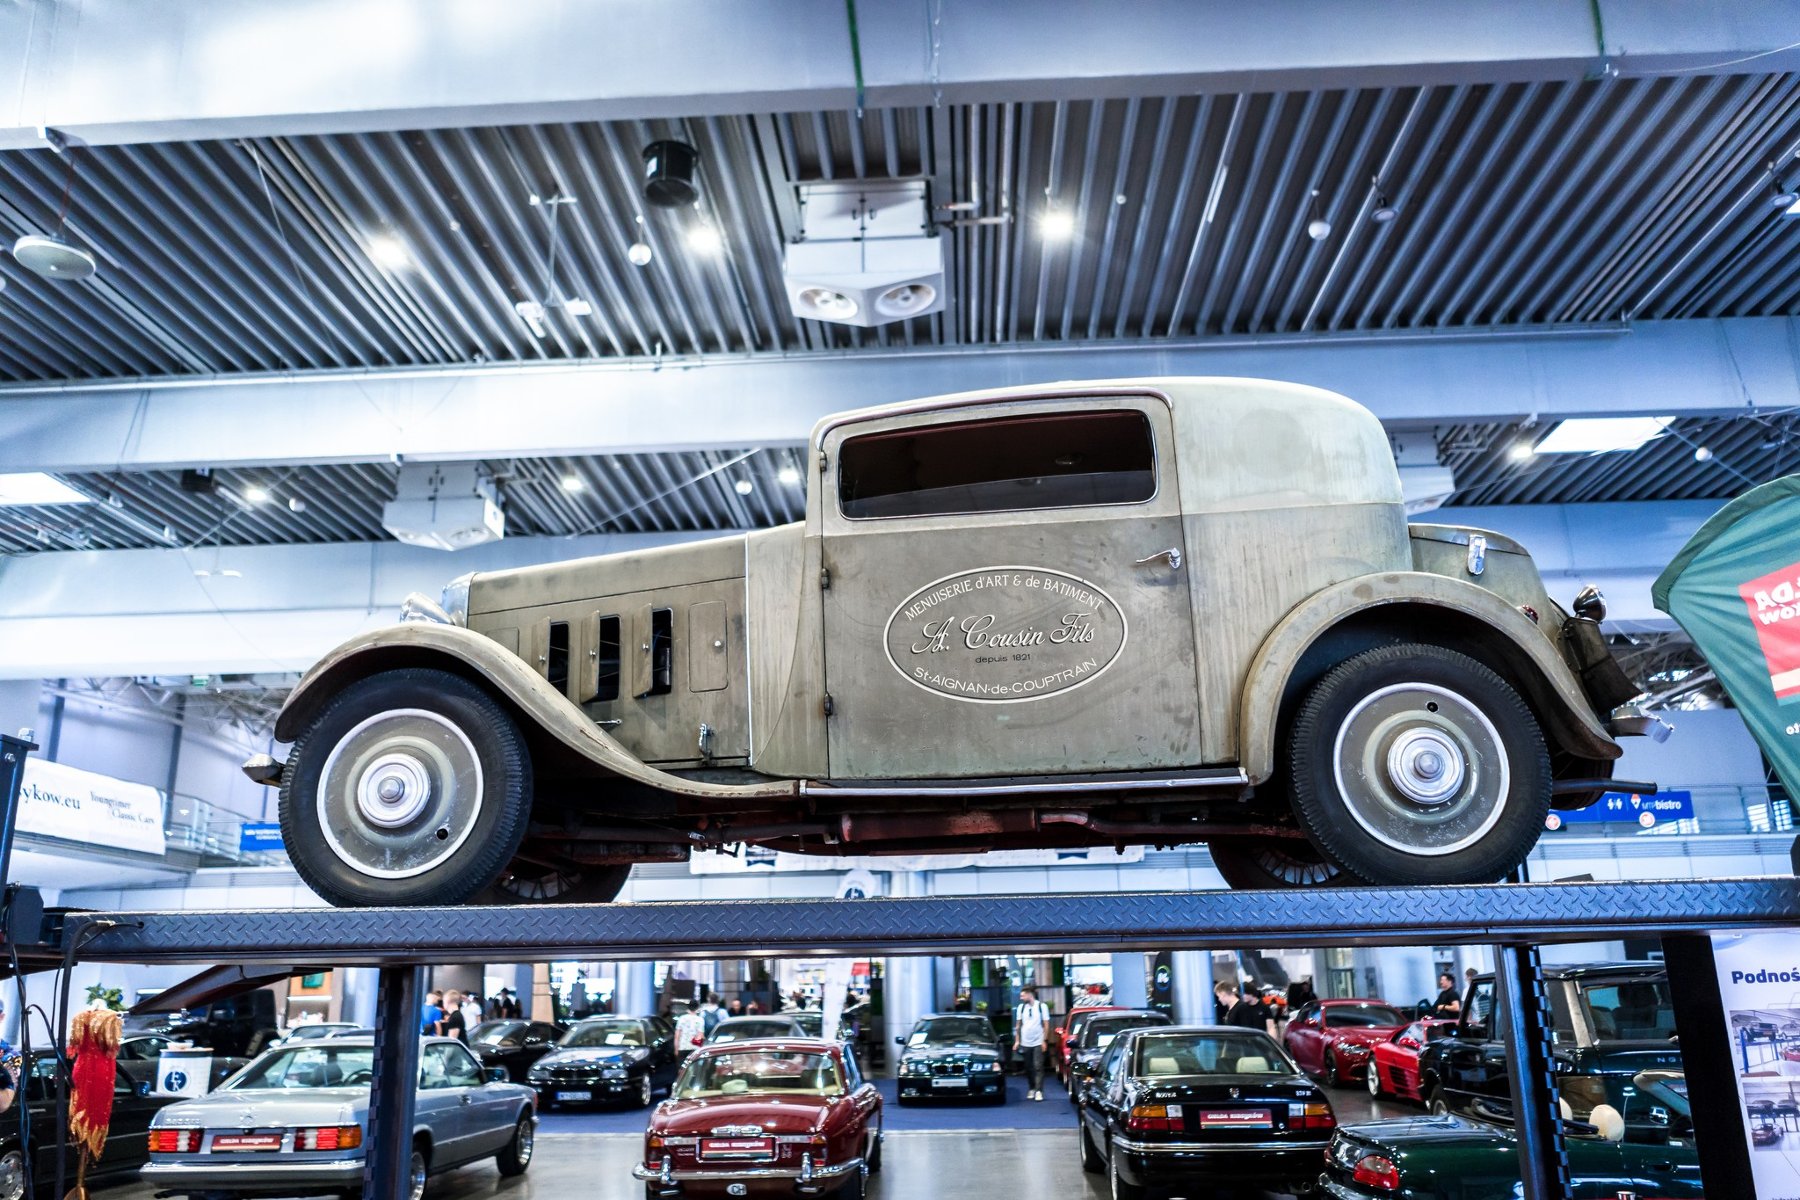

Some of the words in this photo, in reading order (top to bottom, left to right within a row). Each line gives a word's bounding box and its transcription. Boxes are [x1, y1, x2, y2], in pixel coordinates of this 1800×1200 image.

[905, 580, 973, 621] MENUISERIE
[975, 574, 1009, 589] d'ART
[1013, 575, 1022, 585] &
[1025, 576, 1040, 588] de
[1043, 578, 1104, 610] BATIMENT
[911, 616, 955, 654] A.
[960, 614, 1045, 650] Cousin
[975, 654, 1008, 664] depuis
[1012, 653, 1031, 661] 1821
[731, 1185, 746, 1194] CH
